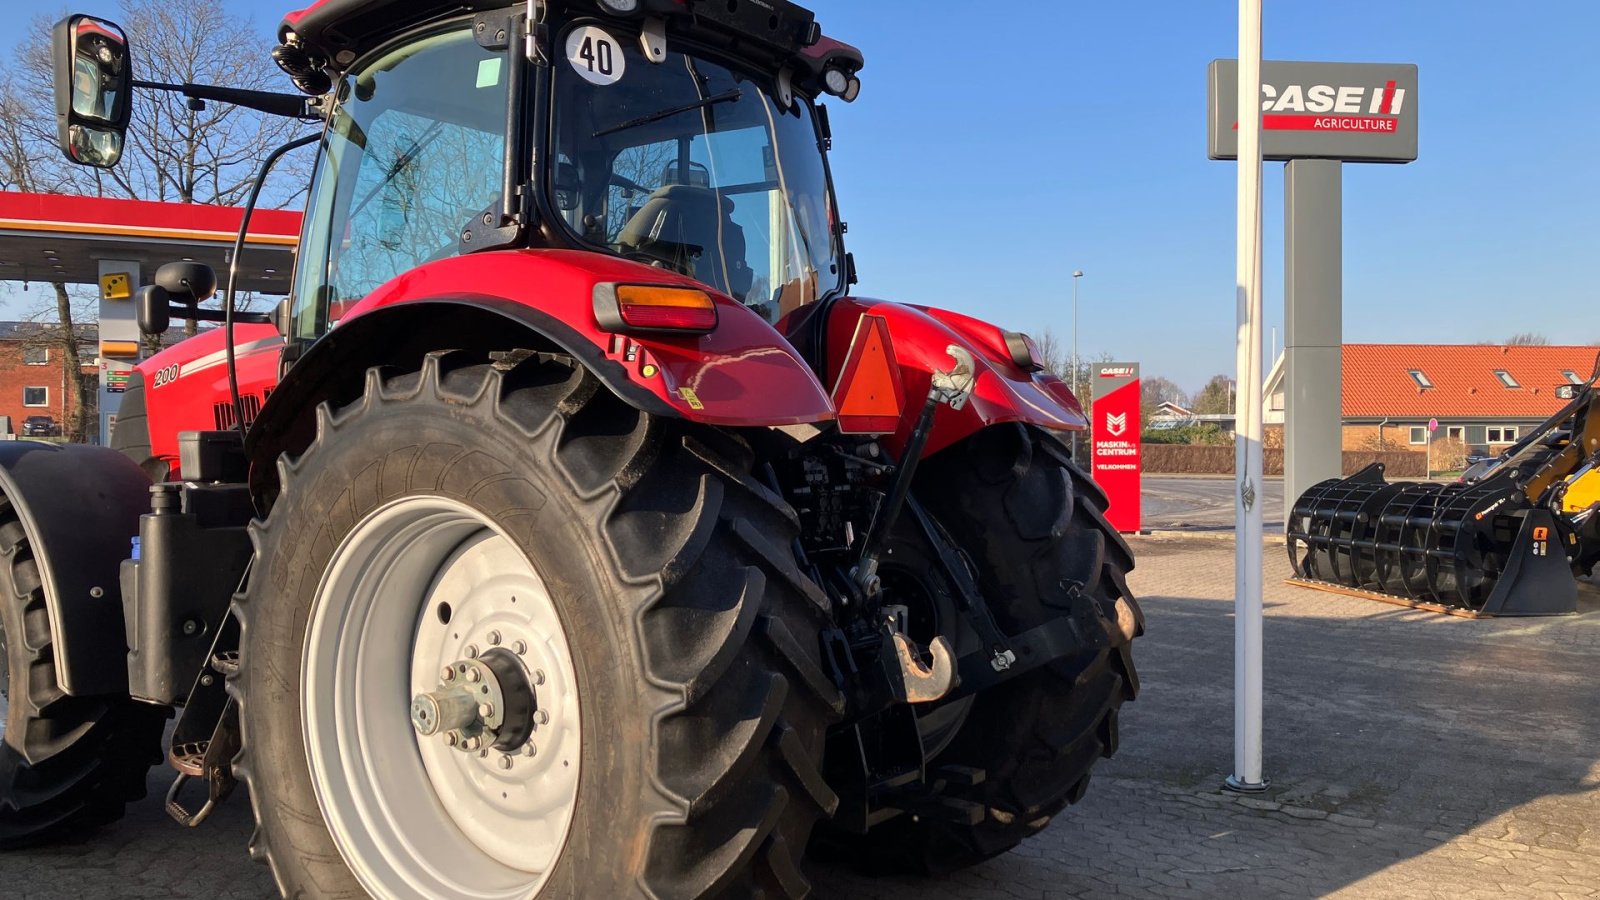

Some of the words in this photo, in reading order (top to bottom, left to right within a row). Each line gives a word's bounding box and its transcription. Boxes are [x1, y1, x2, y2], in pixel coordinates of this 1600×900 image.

[580, 36, 613, 75] 40
[1314, 118, 1393, 131] AGRICULTURE
[153, 363, 178, 388] 200
